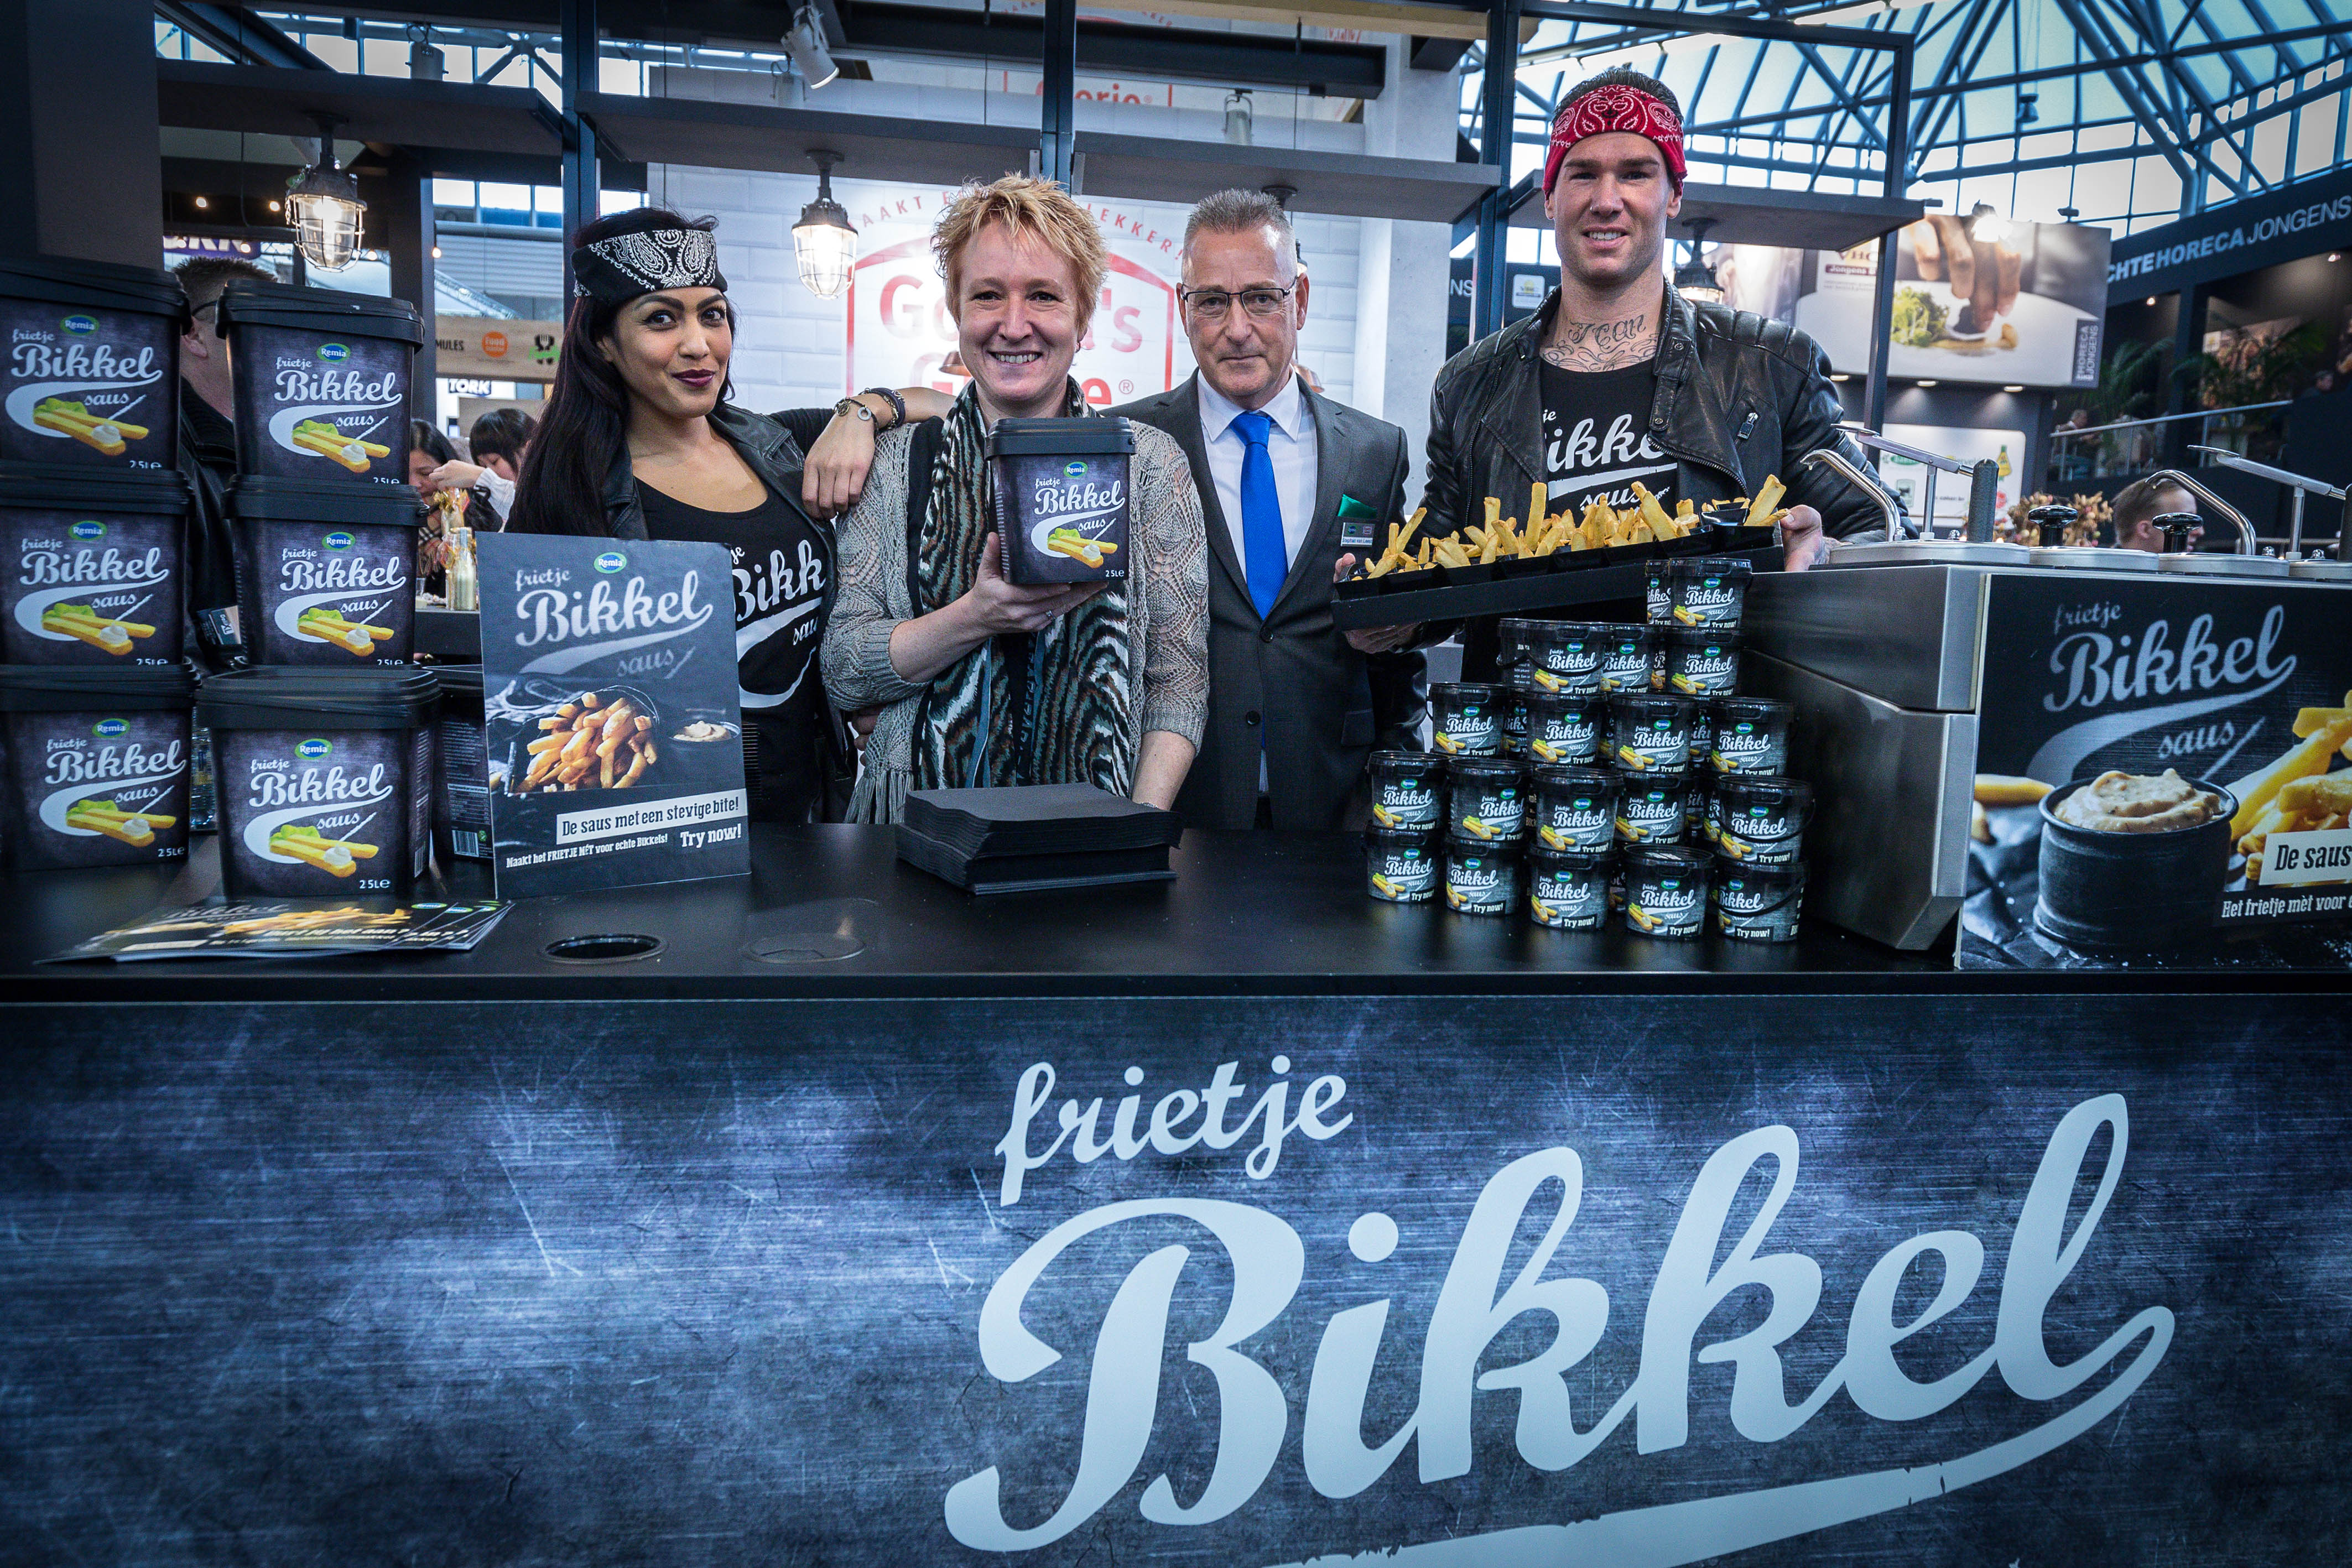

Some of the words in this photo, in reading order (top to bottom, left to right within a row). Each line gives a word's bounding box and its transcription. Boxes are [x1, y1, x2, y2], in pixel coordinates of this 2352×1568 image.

[2156, 227, 2245, 268] HORECA
[2247, 195, 2352, 245] JONGENS
[65, 319, 95, 330] Remia
[12, 329, 55, 343] frietje
[321, 347, 347, 357] Remia
[11, 343, 163, 379] Bikkel
[276, 357, 312, 370] frietje
[274, 369, 403, 402] Bikkel
[449, 378, 491, 395] TORK
[84, 392, 130, 406] saus
[336, 415, 374, 427] saus
[1547, 414, 1666, 472] ikke
[1035, 477, 1061, 489] frietje
[1034, 480, 1125, 515] Bikkel
[73, 527, 102, 536] Remia
[1078, 518, 1106, 531] saus
[20, 538, 63, 552] frietje
[326, 537, 352, 546] Remia
[282, 548, 318, 561] frietje
[598, 557, 624, 569] Remia
[19, 546, 170, 586] Bikkel
[280, 556, 407, 591] Bikkel
[515, 566, 571, 591] frietje
[732, 539, 826, 622] Bikk
[91, 593, 137, 608] saus
[1684, 588, 1735, 605] Bikkel
[340, 599, 378, 613] saus
[515, 570, 714, 647] Bikkel
[2053, 601, 2122, 635] frietje
[793, 617, 819, 645] sau
[616, 645, 675, 678] saus
[1547, 652, 1597, 669] Bikkel
[1603, 654, 1647, 670] Bikkel
[1684, 656, 1733, 673] Bikkel
[2043, 605, 2297, 712] Bikkel
[97, 724, 126, 732] Remia
[1445, 716, 1494, 732] Bikkel
[1545, 722, 1594, 740] Bikkel
[46, 738, 88, 752] frietje
[1632, 730, 1684, 747] Bikkel
[1718, 734, 1771, 751] Bikkel
[2158, 720, 2236, 759] saus
[299, 745, 328, 754] Remia
[45, 739, 187, 784] Bikkel
[251, 758, 290, 773] frietje
[249, 763, 393, 808] Bikkel
[115, 787, 159, 803] saus
[1383, 789, 1433, 805] Bikkel
[562, 820, 577, 836] De
[581, 817, 611, 834] saus
[615, 813, 639, 828] met
[642, 810, 664, 825] een
[667, 803, 711, 821] stevige
[712, 796, 739, 814] bite!
[1552, 808, 1607, 827] Bikkel
[1627, 801, 1678, 819] Bikkel
[316, 812, 360, 830] saus
[1731, 817, 1787, 835] Bikkel
[680, 830, 706, 849] Try
[707, 824, 741, 844] now!
[506, 855, 532, 868] Maakt
[533, 852, 546, 863] het
[547, 848, 577, 862] FRIETJE
[595, 842, 614, 855] voor
[615, 838, 636, 851] echte
[2274, 844, 2300, 871] De
[2303, 845, 2352, 869] saus
[1384, 858, 1433, 876] Bikkel
[1450, 869, 1499, 885] Bikkel
[1538, 882, 1591, 899] Bikkel
[1640, 889, 1696, 908] Bikkel
[1719, 893, 1764, 909] Bikkel
[2221, 899, 2244, 918] Het
[2245, 897, 2286, 918] frietje
[2287, 894, 2314, 913] mèt
[2315, 895, 2347, 911] voor
[996, 1054, 1355, 1207] frietje
[944, 1091, 2176, 1554] Bikkel
